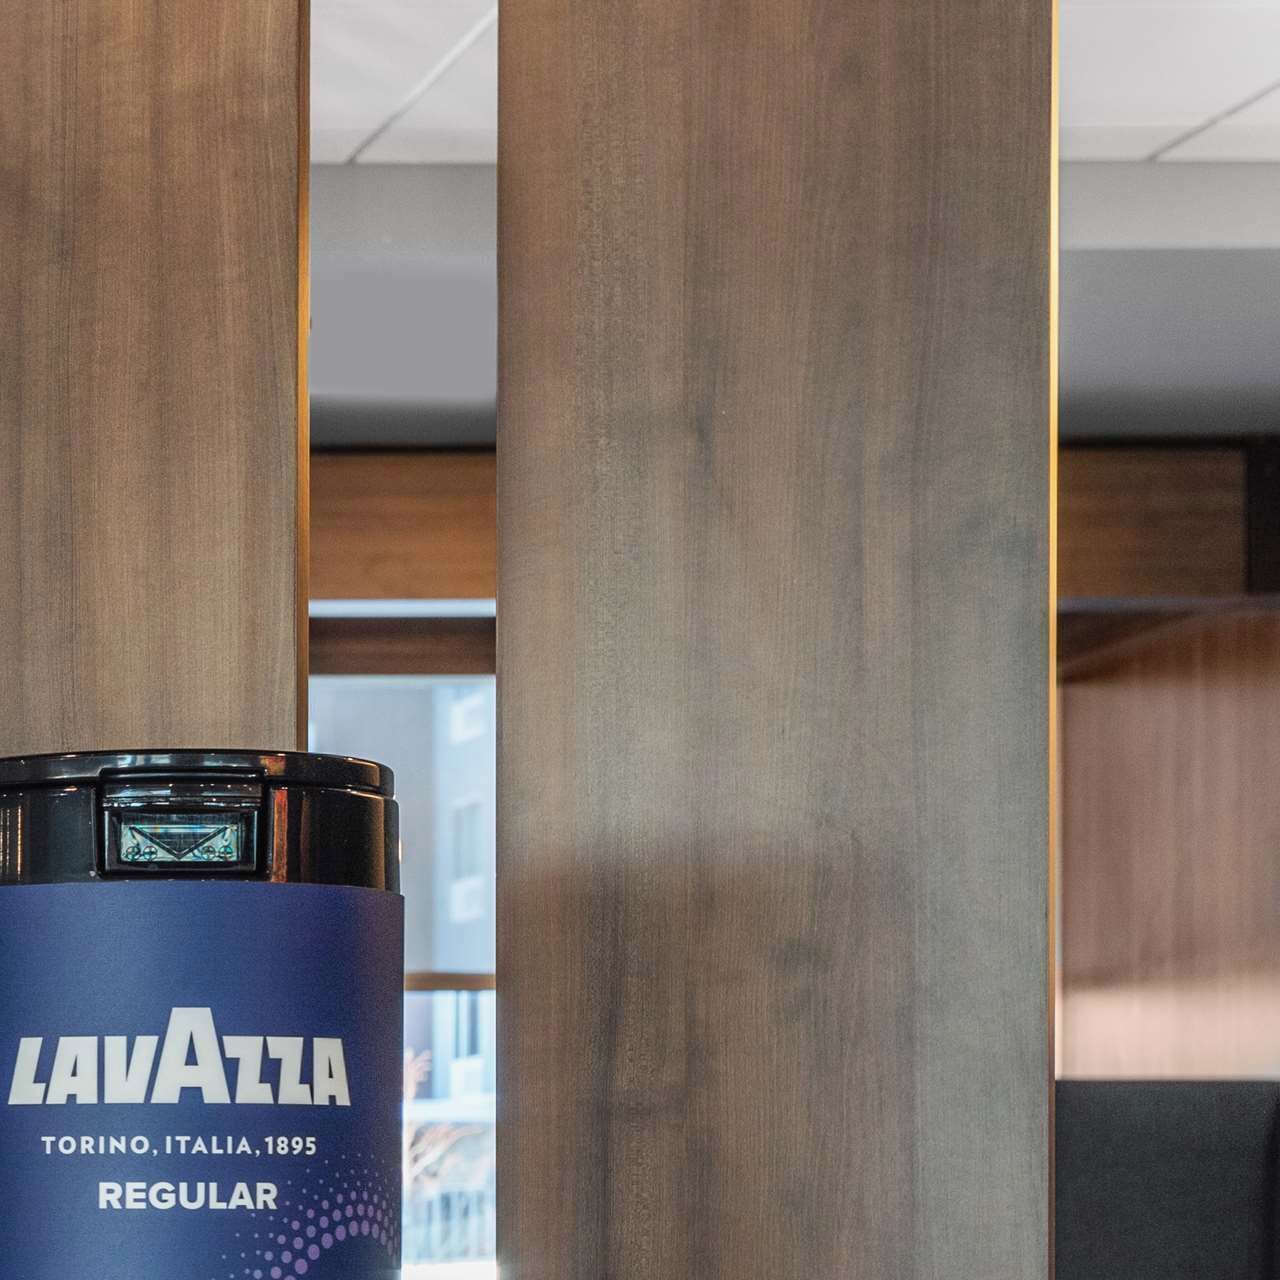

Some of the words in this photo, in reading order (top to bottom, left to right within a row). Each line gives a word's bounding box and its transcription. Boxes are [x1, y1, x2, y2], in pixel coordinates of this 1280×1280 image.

[7, 1006, 352, 1106] LAVAZZA
[264, 1135, 317, 1156] 1895
[98, 1181, 279, 1211] REGULAR
